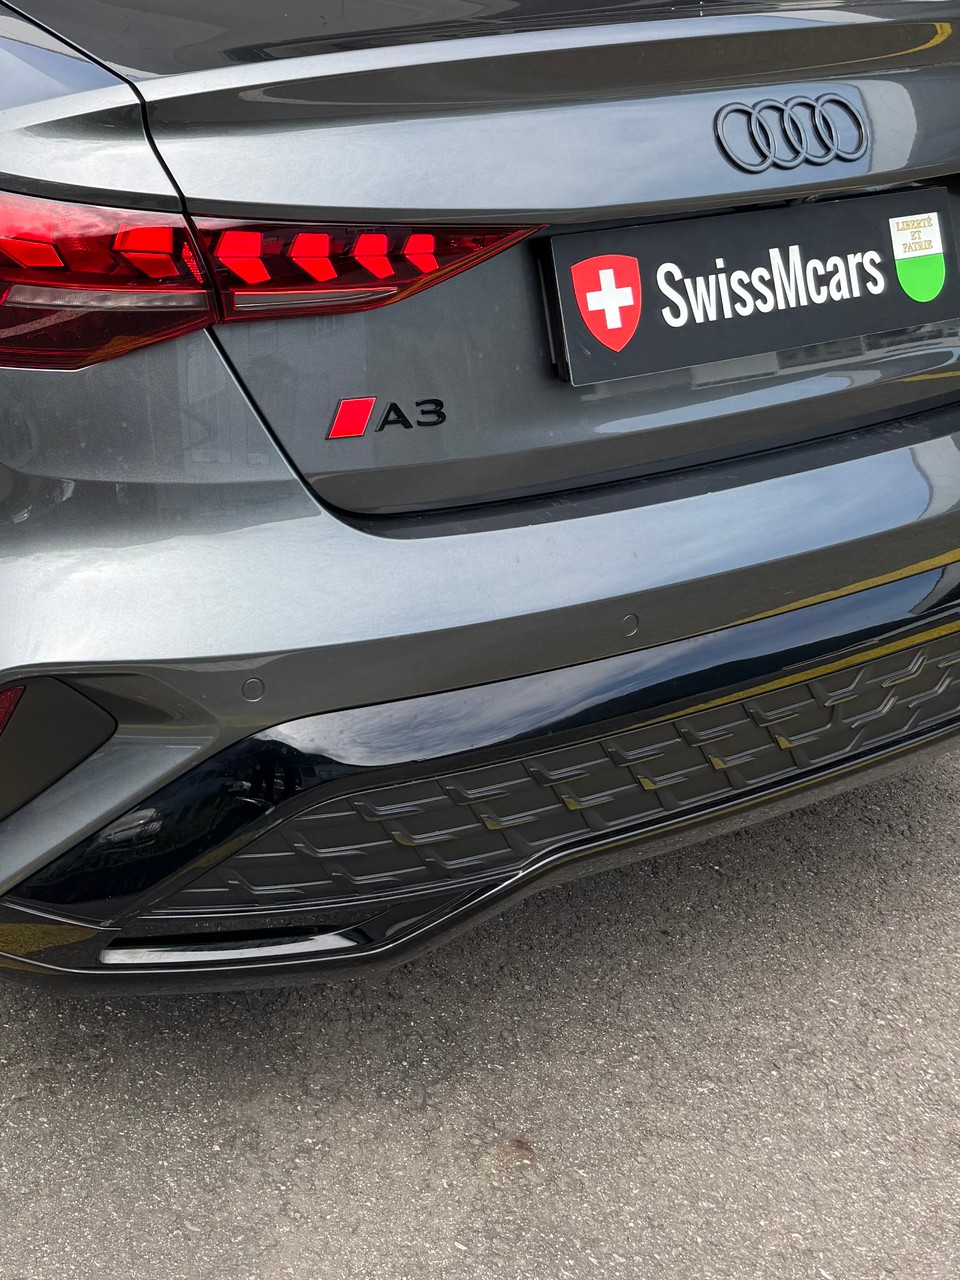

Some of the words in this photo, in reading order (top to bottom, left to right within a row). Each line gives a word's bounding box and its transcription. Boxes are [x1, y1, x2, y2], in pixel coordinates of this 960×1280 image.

[895, 215, 933, 232] LIBERTÉ
[910, 230, 922, 241] ET
[902, 240, 934, 254] PATRIE
[656, 245, 885, 328] SwissMcars
[374, 398, 447, 432] A3
